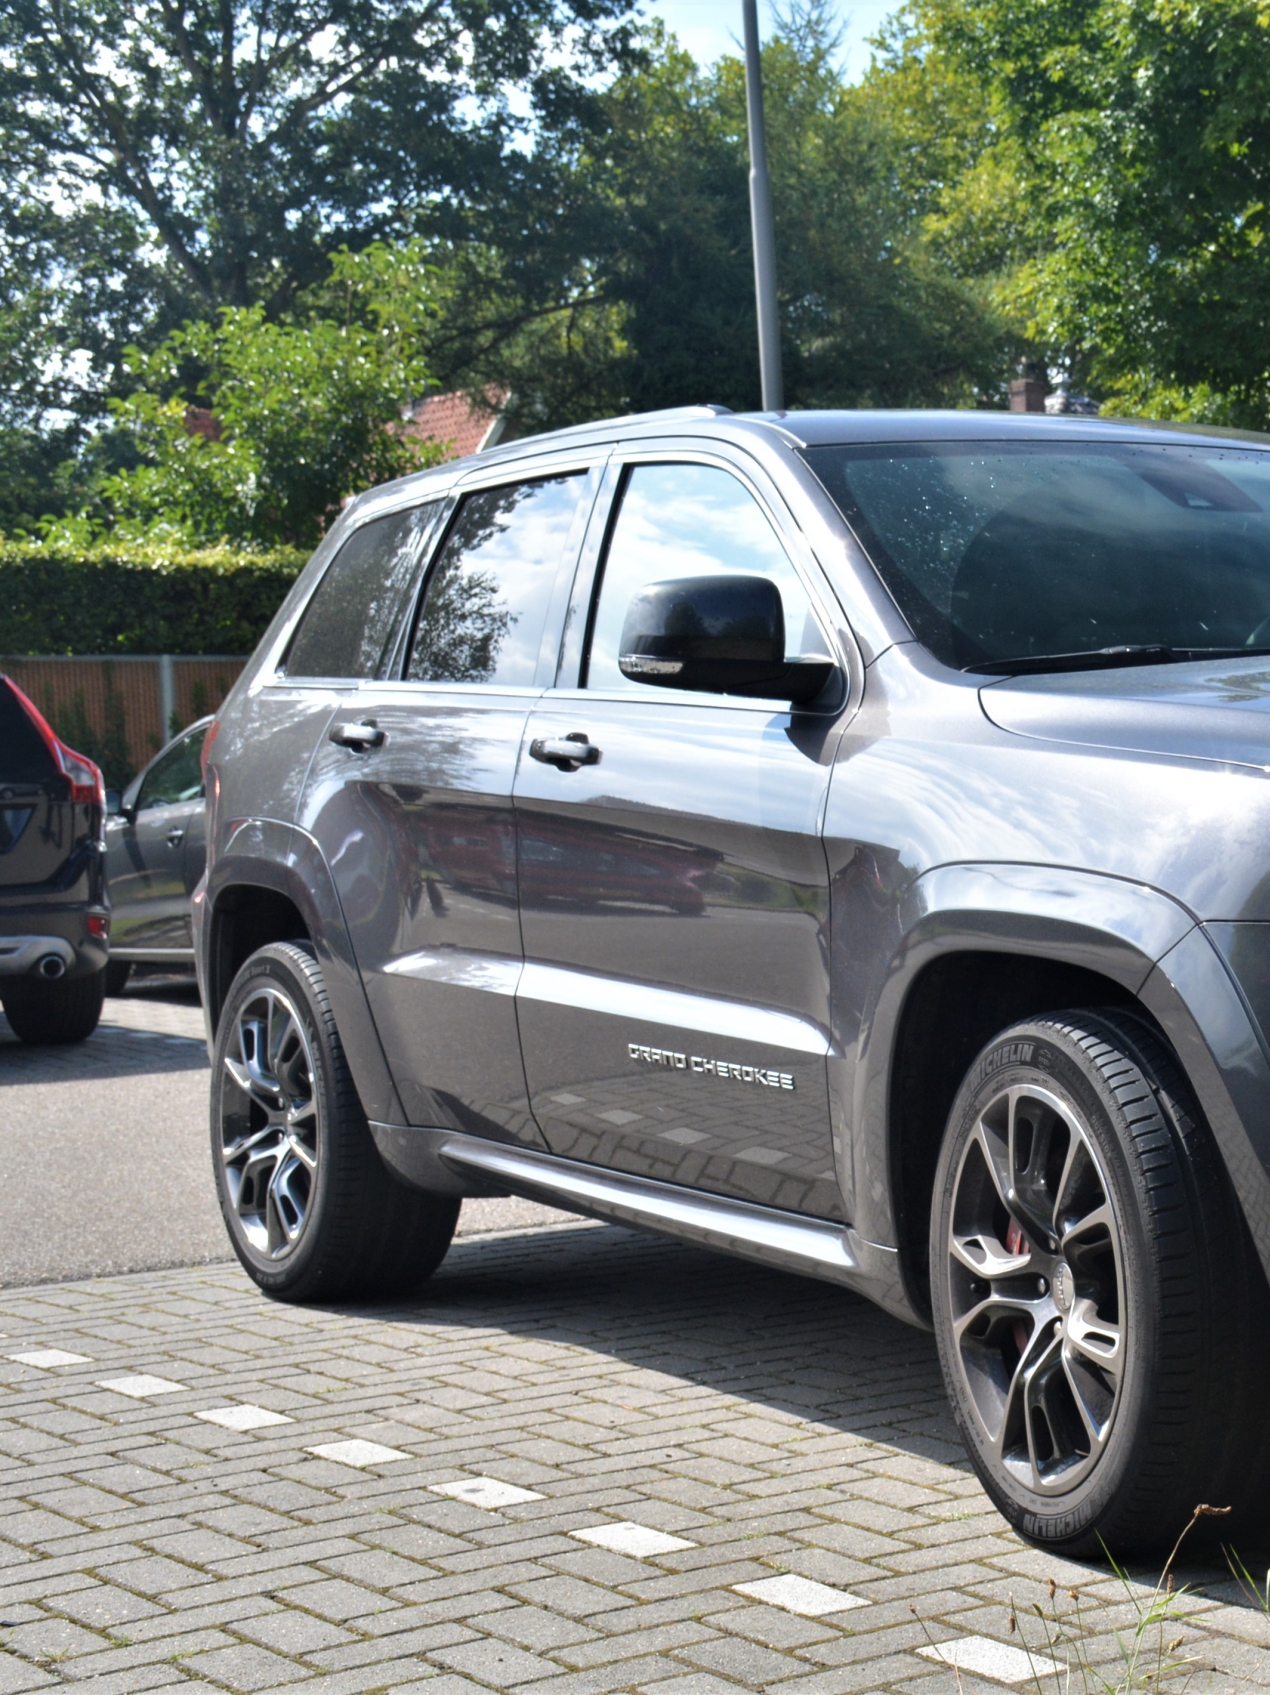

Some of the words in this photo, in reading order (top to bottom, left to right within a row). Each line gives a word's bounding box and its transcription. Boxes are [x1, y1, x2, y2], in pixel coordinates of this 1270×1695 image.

[628, 1043, 687, 1069] GRAND
[690, 1056, 794, 1090] CHEROKEE
[971, 1043, 1035, 1091] MICHELIN
[1022, 1501, 1093, 1537] MICHELIN
